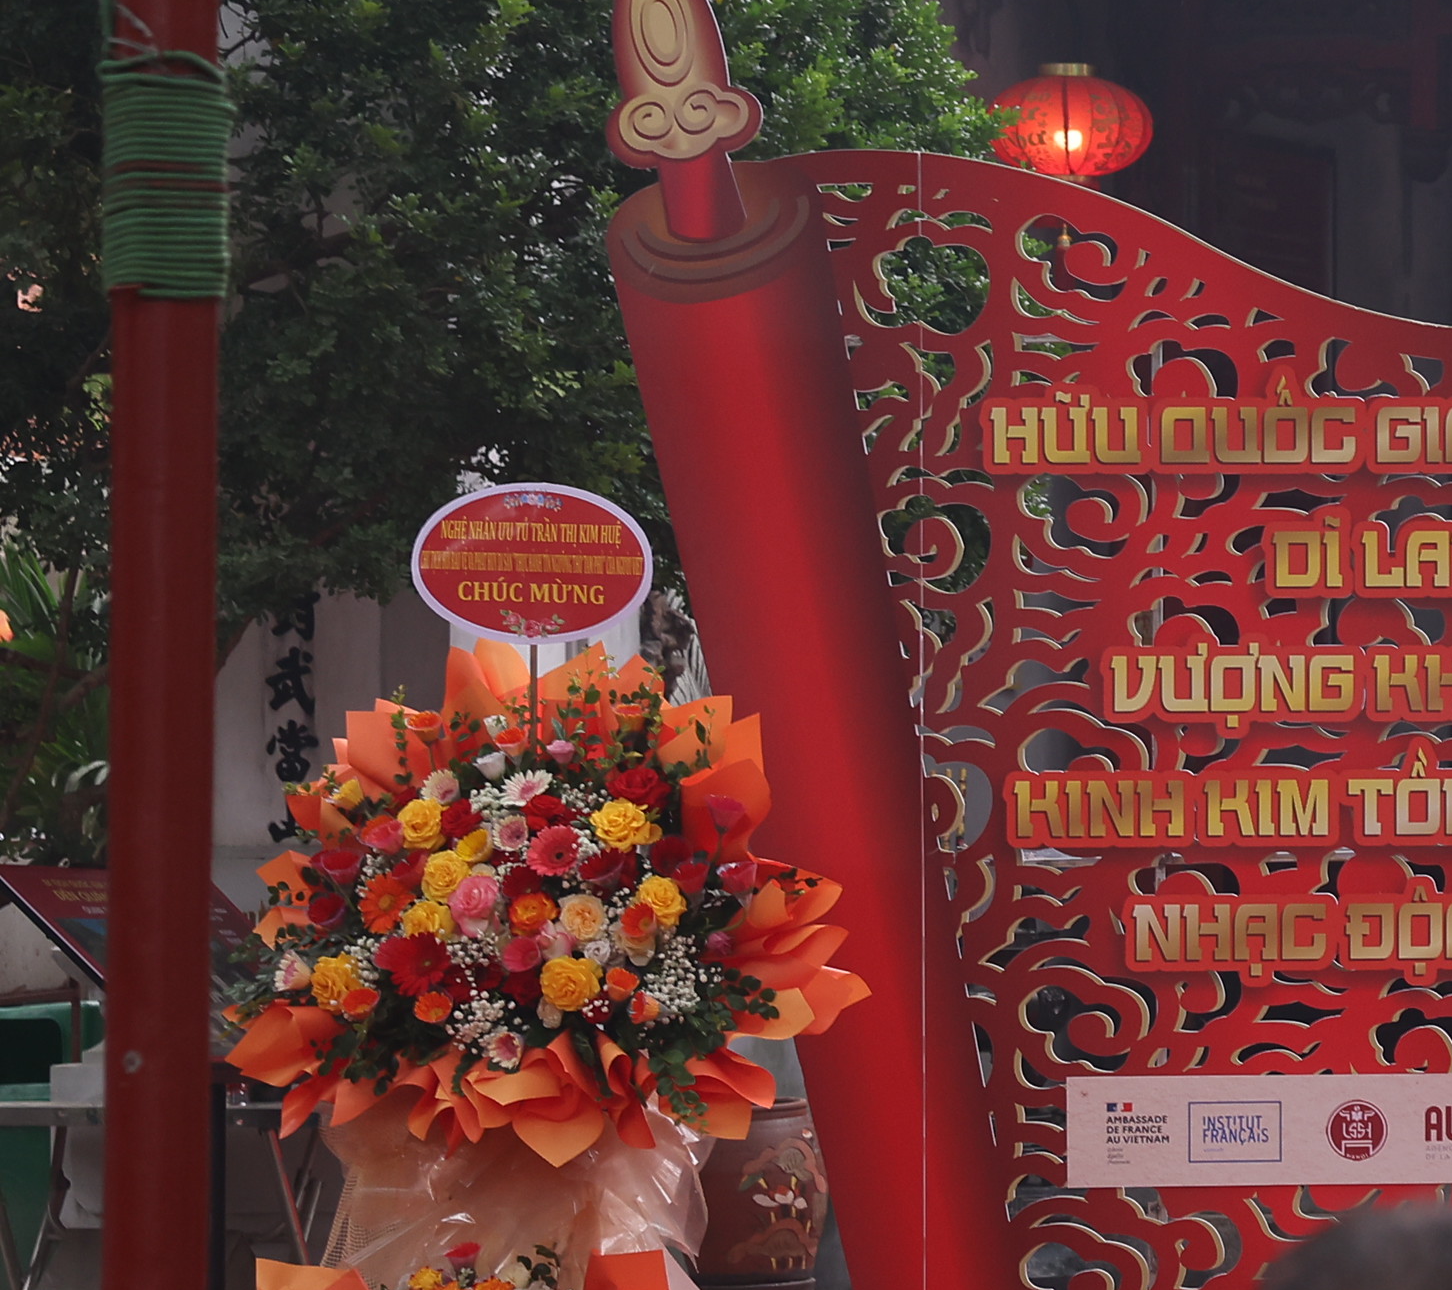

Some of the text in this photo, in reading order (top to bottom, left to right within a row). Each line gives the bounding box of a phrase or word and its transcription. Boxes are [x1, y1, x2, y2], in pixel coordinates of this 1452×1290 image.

[992, 391, 1142, 464] HỮU
[1159, 374, 1357, 464] QUỐC
[559, 523, 577, 547] THỊ
[579, 523, 600, 544] KIM
[601, 520, 622, 549] HUỆ
[457, 577, 605, 605] CHÚC MỪNG
[1110, 642, 1355, 727] VƯỢNG
[1013, 780, 1185, 838] KINH
[1204, 779, 1329, 837] KIM
[1133, 903, 1326, 976] NHẠC
[1106, 1115, 1168, 1124] AMBASSADE
[1106, 1125, 1163, 1134] DE FRANCE
[1203, 1115, 1263, 1129] INSTITUT
[1106, 1135, 1170, 1144] AU VIETNAM
